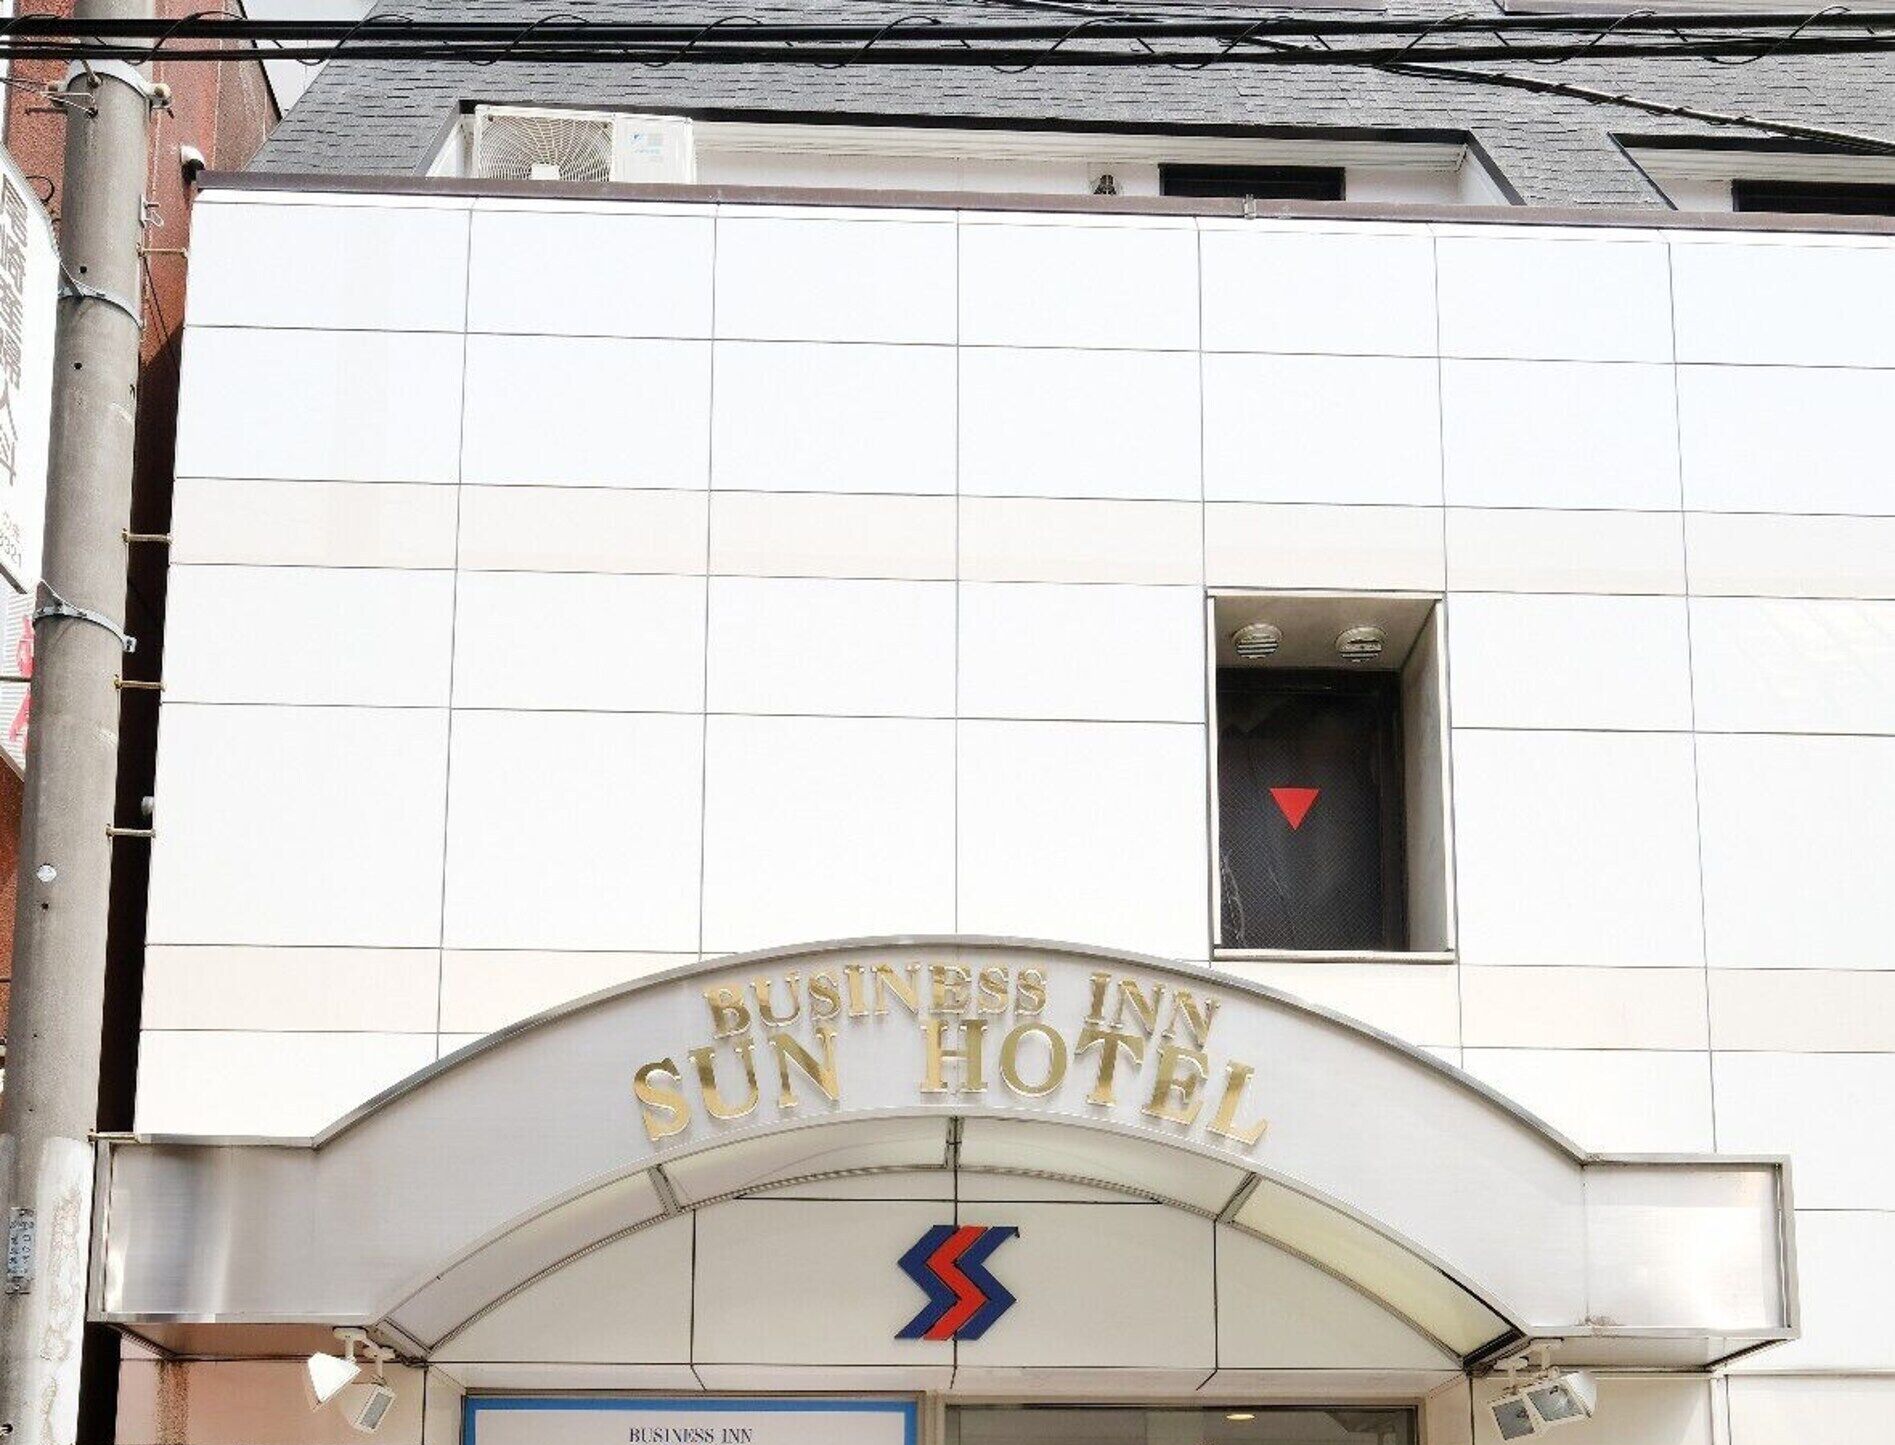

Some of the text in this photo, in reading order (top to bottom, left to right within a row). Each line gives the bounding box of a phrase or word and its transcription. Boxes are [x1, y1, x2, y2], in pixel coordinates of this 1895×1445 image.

[704, 962, 1220, 1049] BUSINESS INN
[634, 1019, 1269, 1146] SUN HOTEL
[629, 1427, 753, 1444] BUSINESS INN
